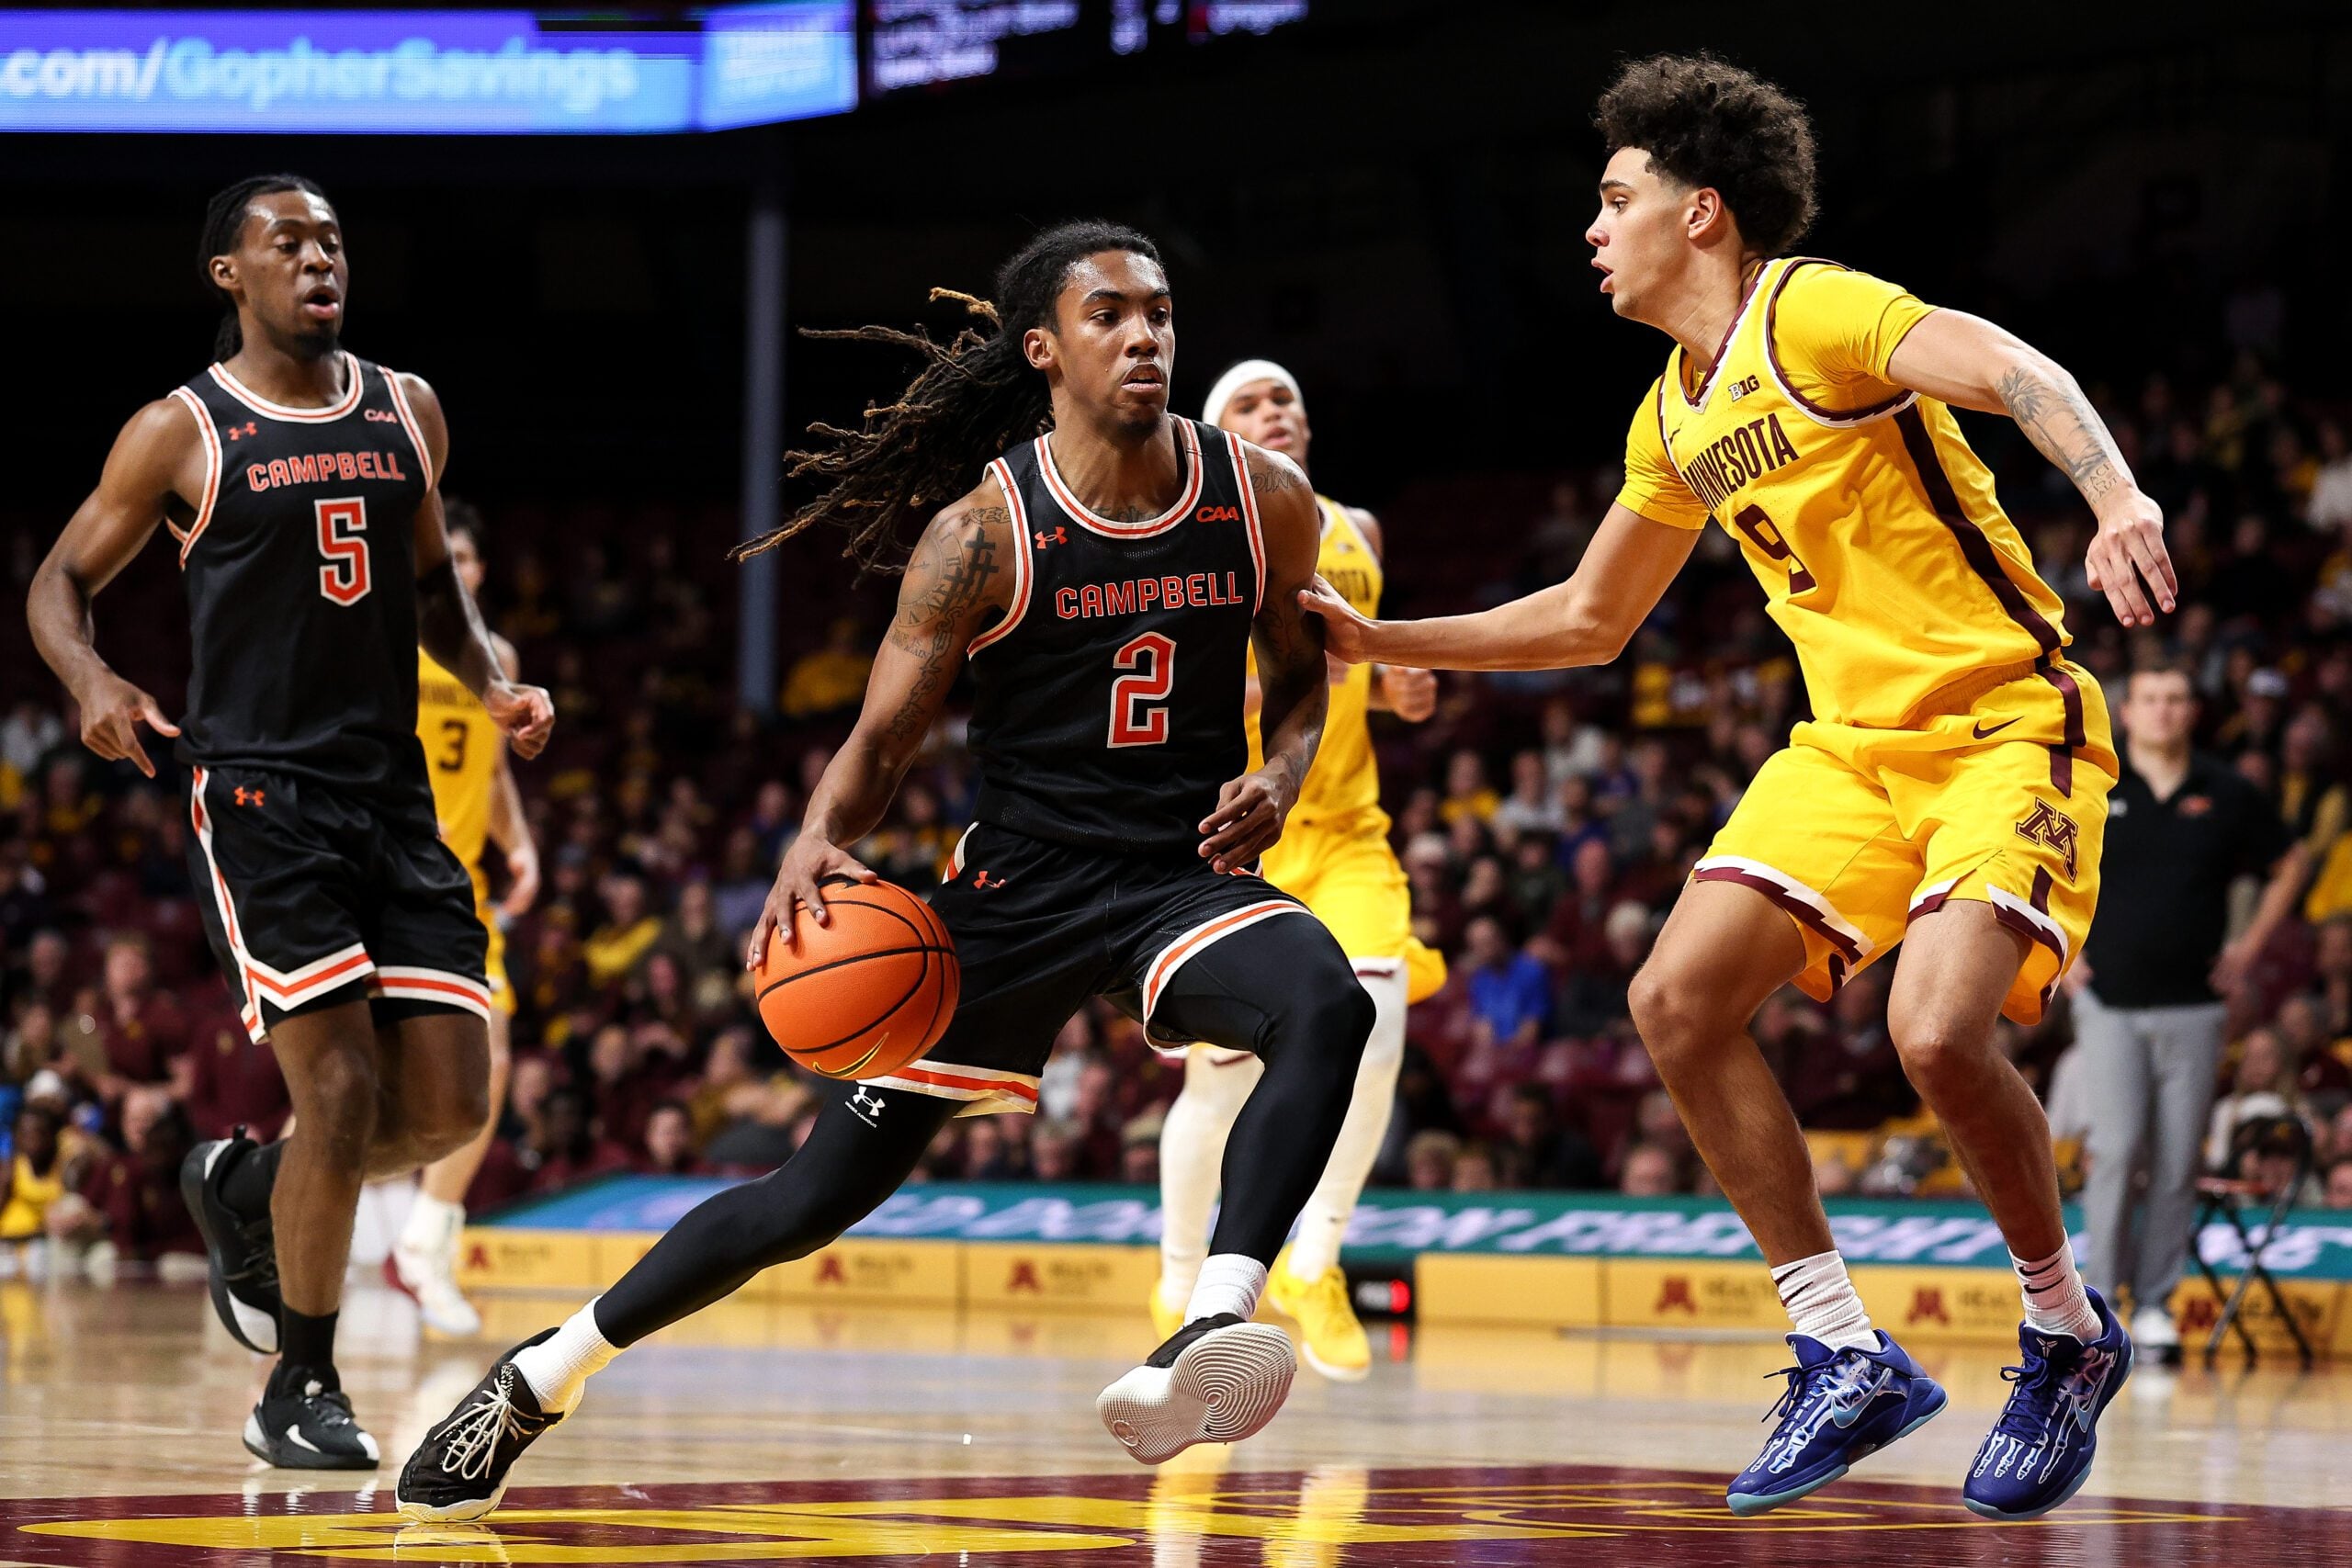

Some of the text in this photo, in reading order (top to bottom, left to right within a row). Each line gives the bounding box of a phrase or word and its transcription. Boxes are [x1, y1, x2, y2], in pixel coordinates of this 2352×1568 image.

[363, 408, 399, 424] CAA
[246, 451, 406, 492] CAMPBELL
[1195, 506, 1239, 523] CAA
[313, 495, 372, 608] 5
[1734, 503, 1817, 594] 9
[1056, 571, 1244, 620] CAMPBELL
[1106, 631, 1177, 749] 2
[437, 717, 469, 773] 3
